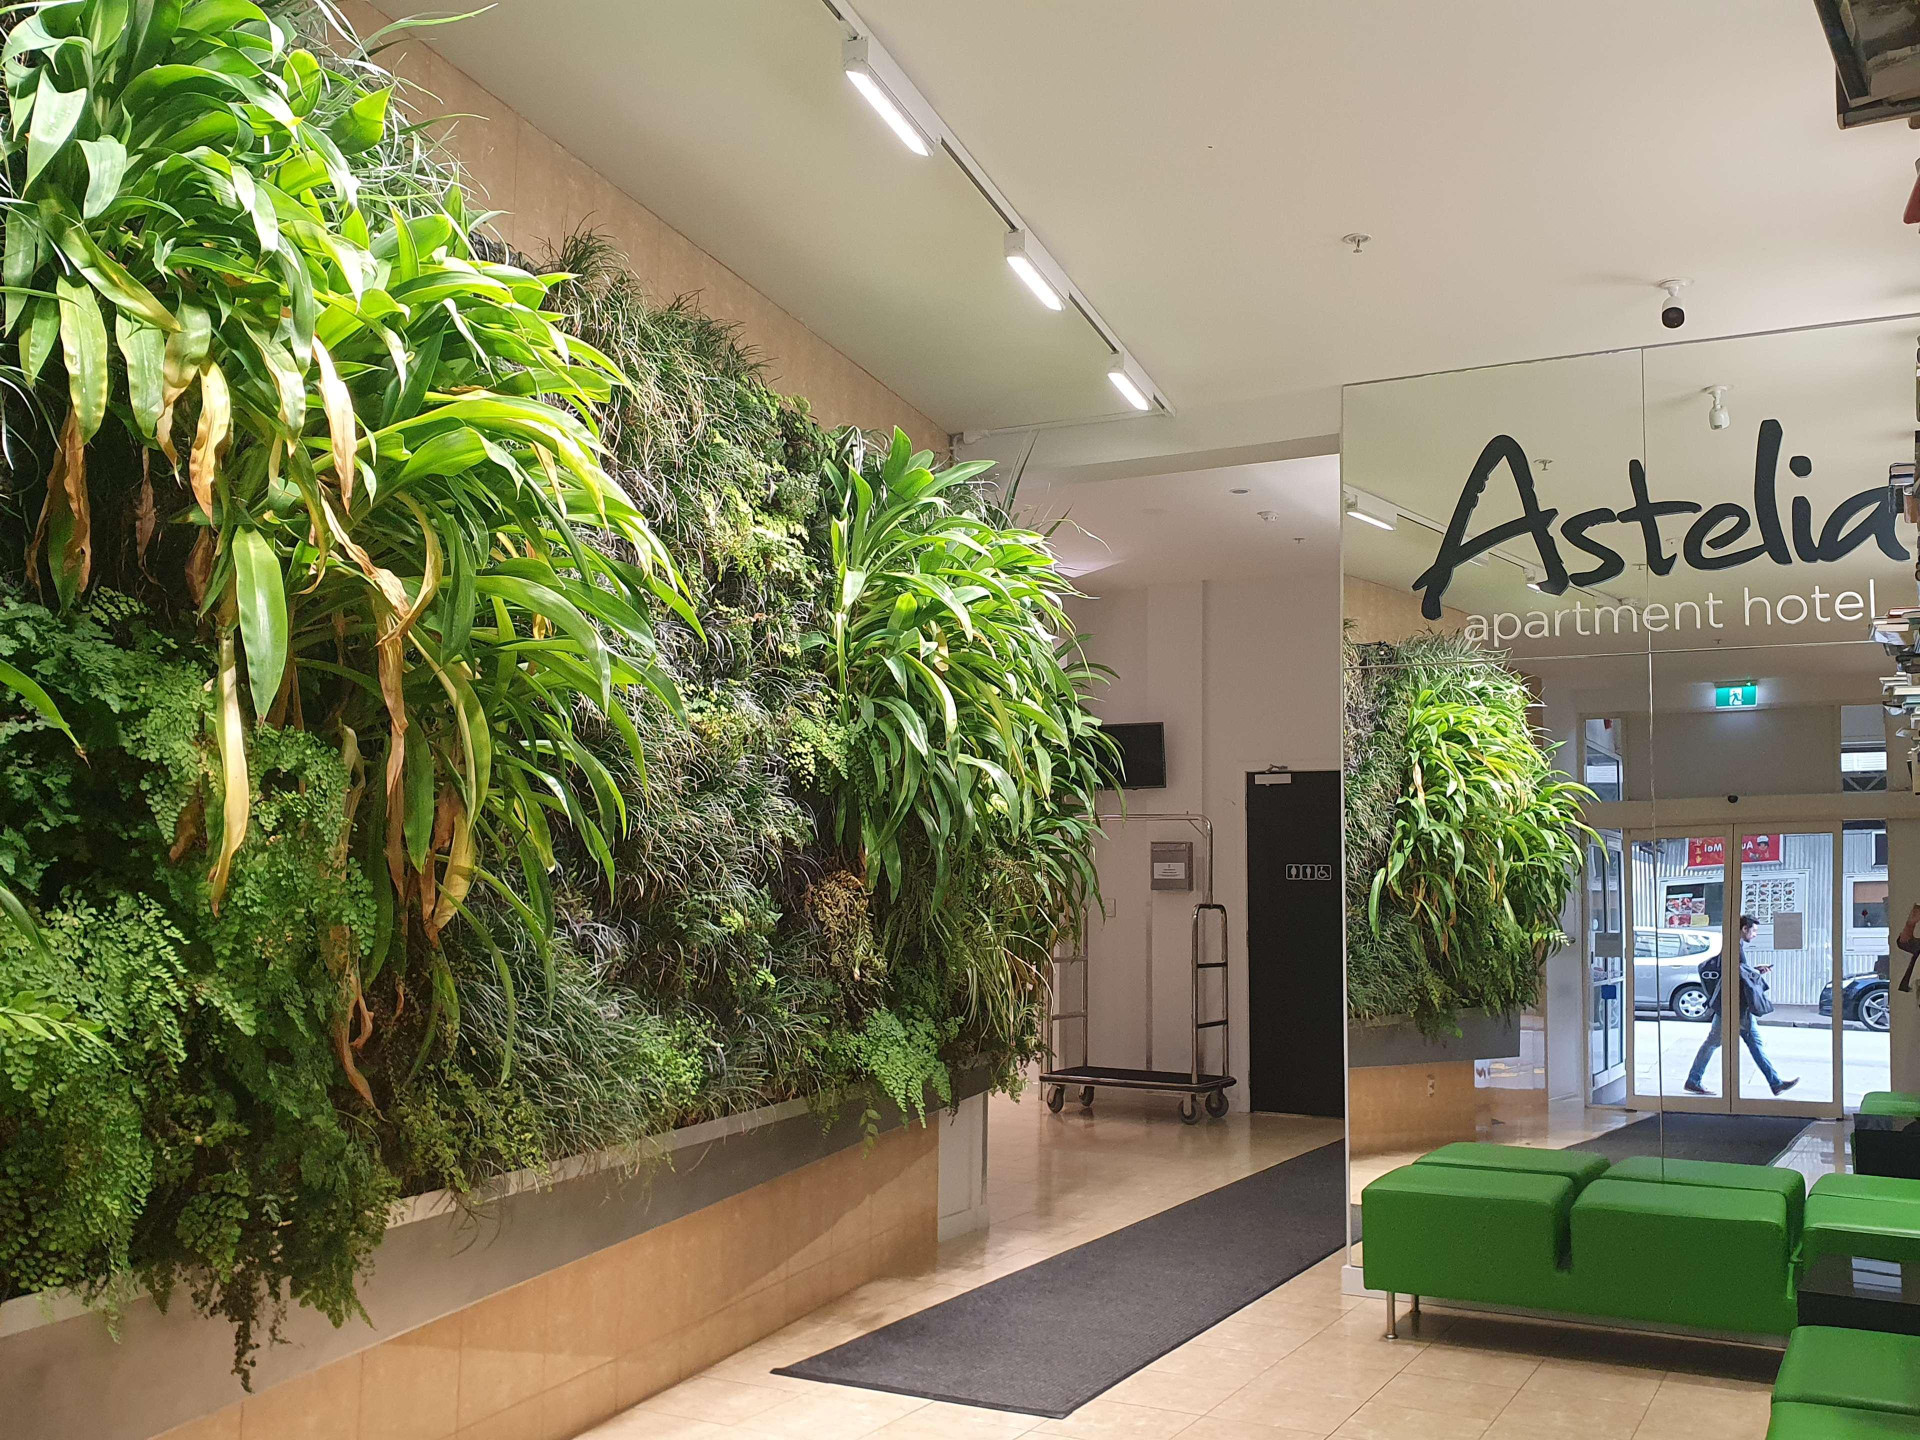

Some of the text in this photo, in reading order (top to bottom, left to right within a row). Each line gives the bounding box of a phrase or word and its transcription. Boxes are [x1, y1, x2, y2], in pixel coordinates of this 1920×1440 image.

[1412, 419, 1910, 620] Astelia
[1464, 579, 1875, 648] apartment hotel
